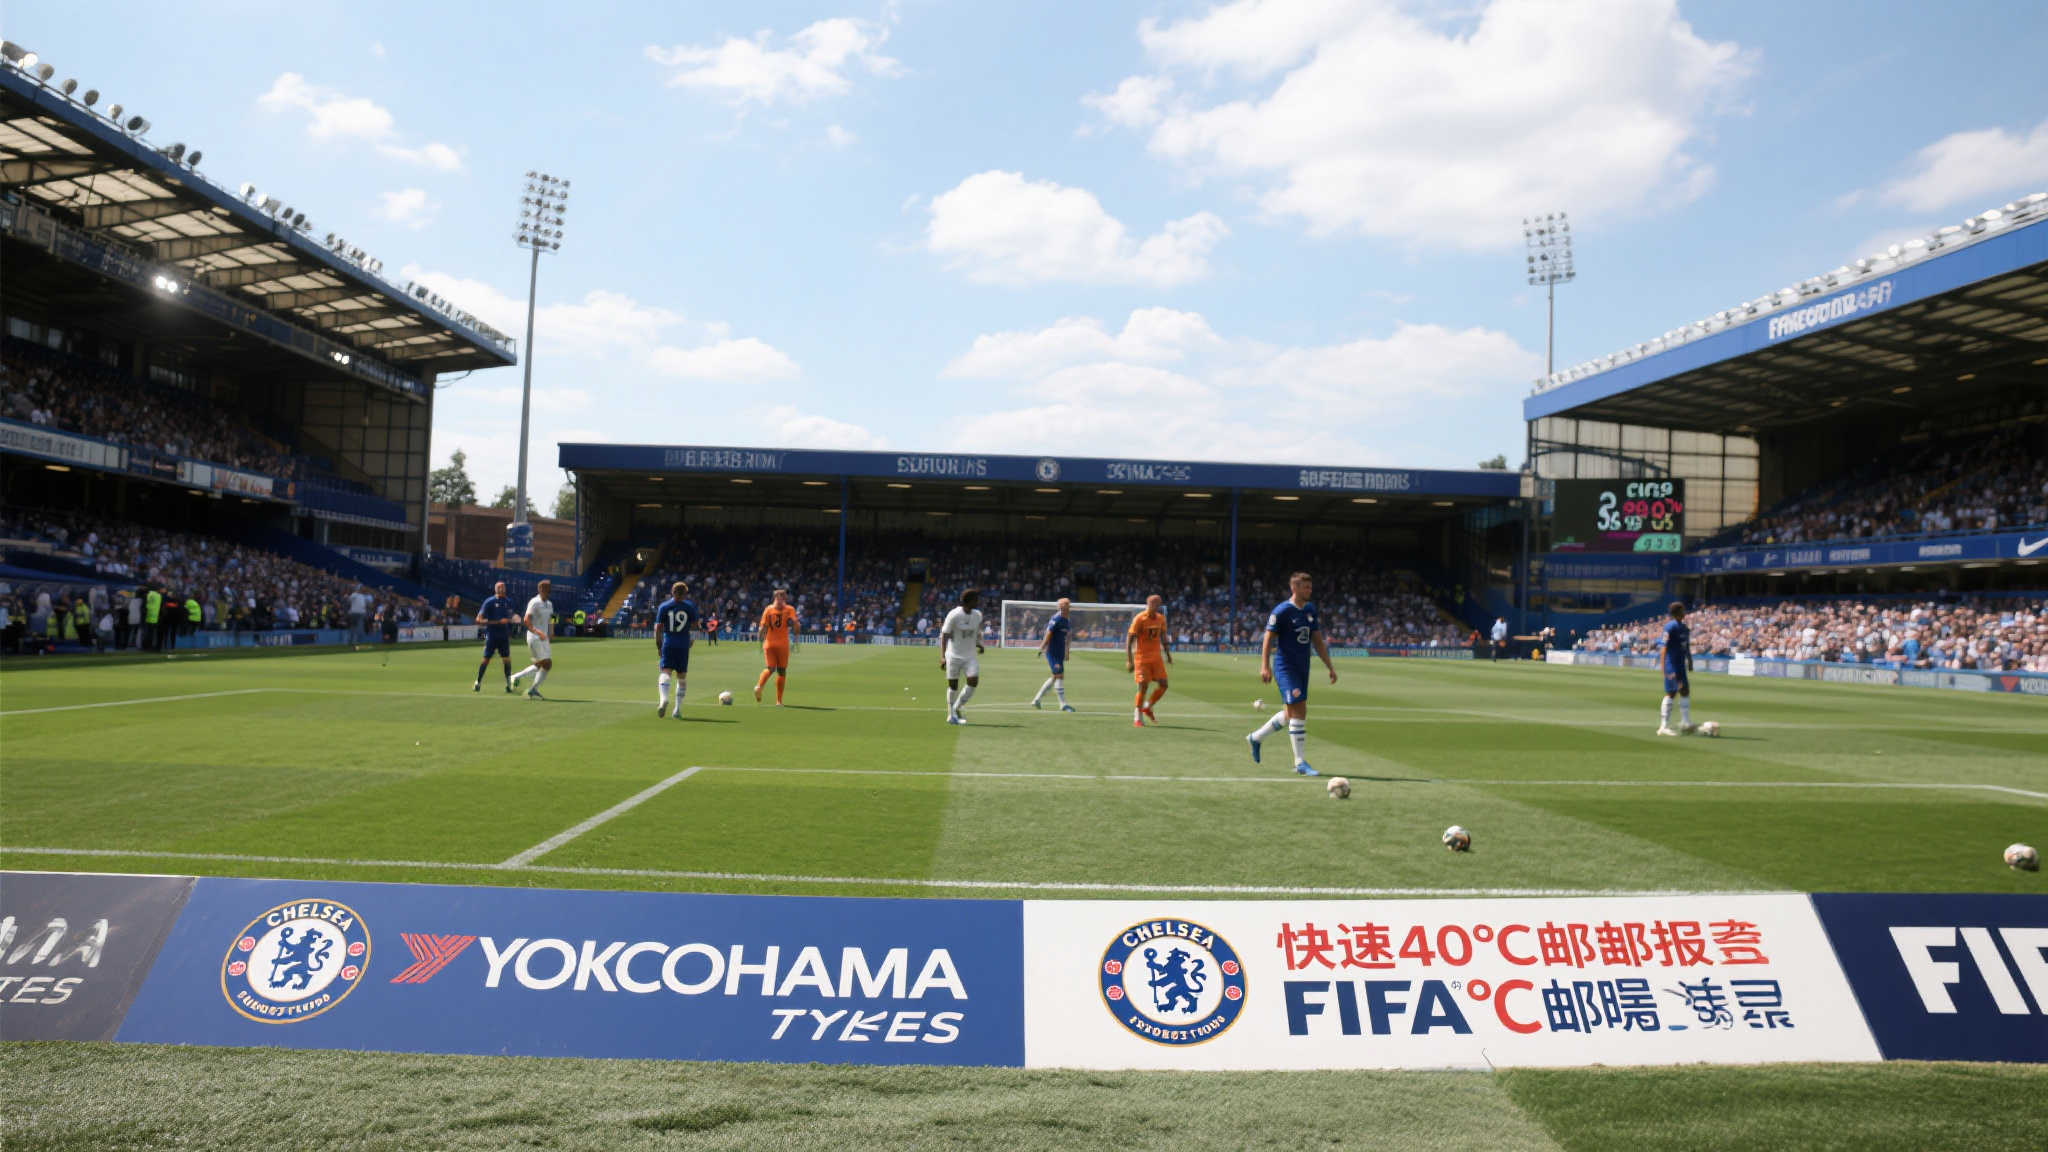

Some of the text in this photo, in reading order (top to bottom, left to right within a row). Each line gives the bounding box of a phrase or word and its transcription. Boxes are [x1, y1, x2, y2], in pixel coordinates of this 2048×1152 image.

[668, 610, 688, 632] 19
[267, 903, 353, 932] CHELSEA
[1122, 922, 1214, 949] CHELSEA
[479, 936, 968, 999] YOKCOHAMA
